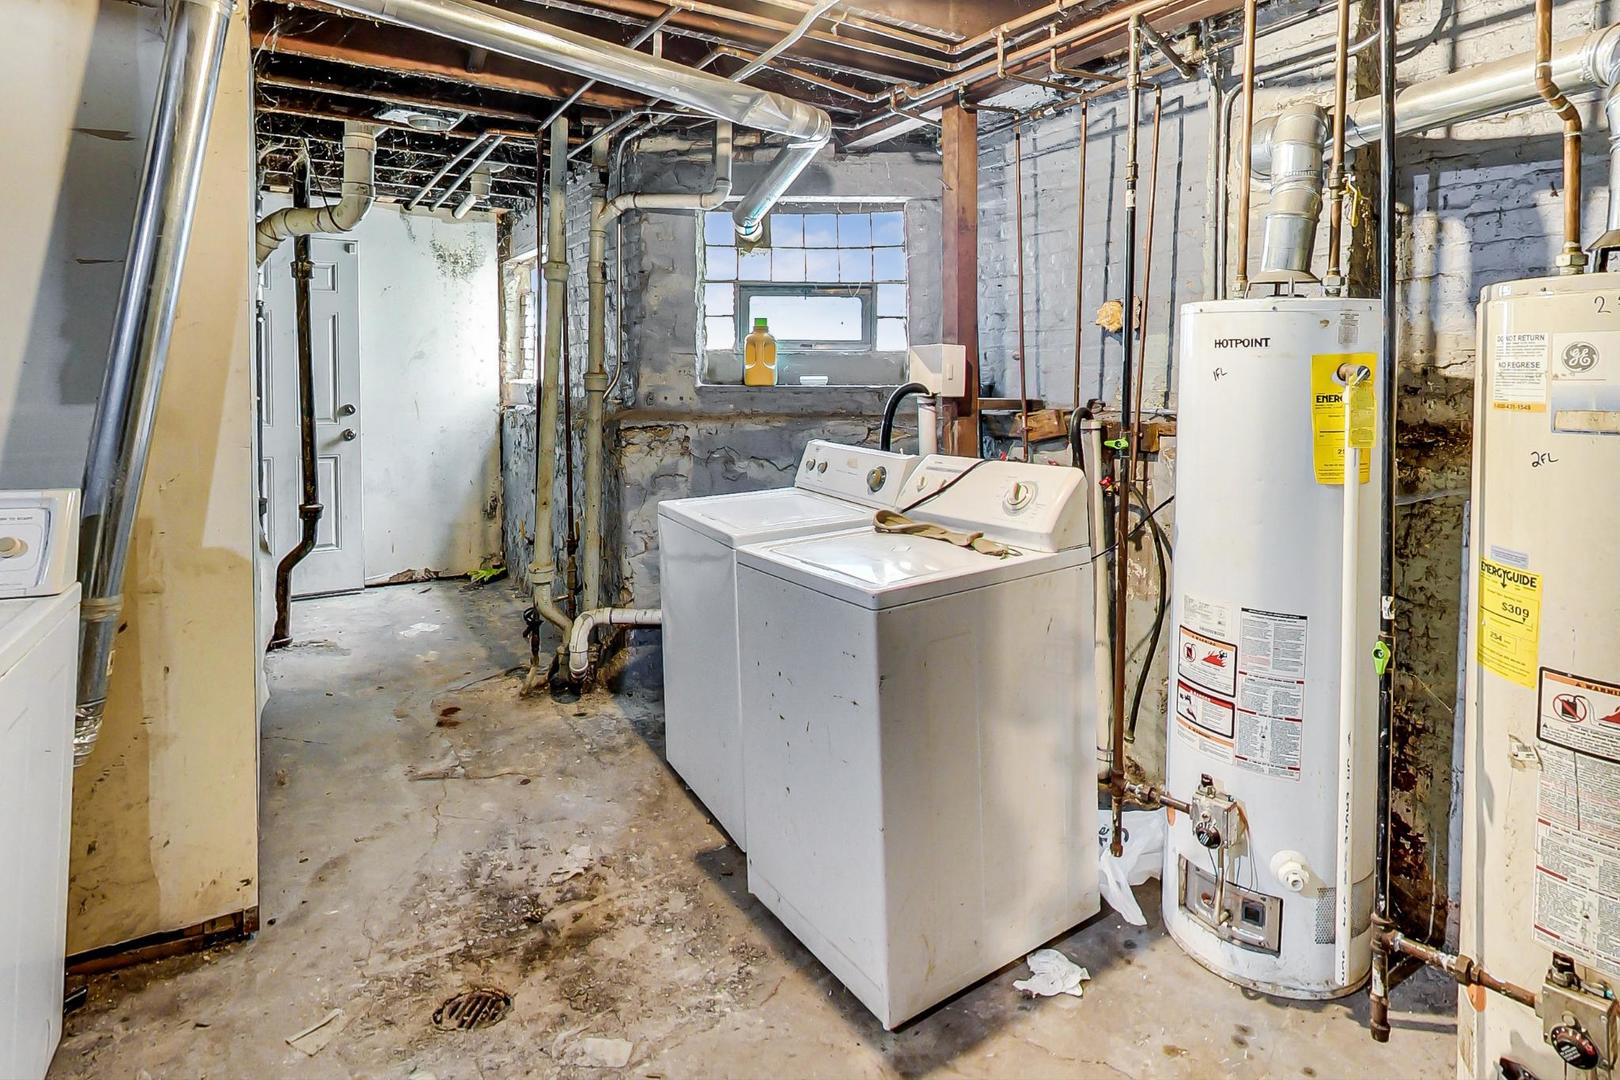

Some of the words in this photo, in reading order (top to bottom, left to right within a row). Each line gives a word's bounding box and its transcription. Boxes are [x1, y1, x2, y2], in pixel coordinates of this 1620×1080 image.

[1214, 337, 1271, 348] HOTPOINT
[1508, 361, 1541, 369] REGRESE
[1531, 451, 1559, 468] 2FL
